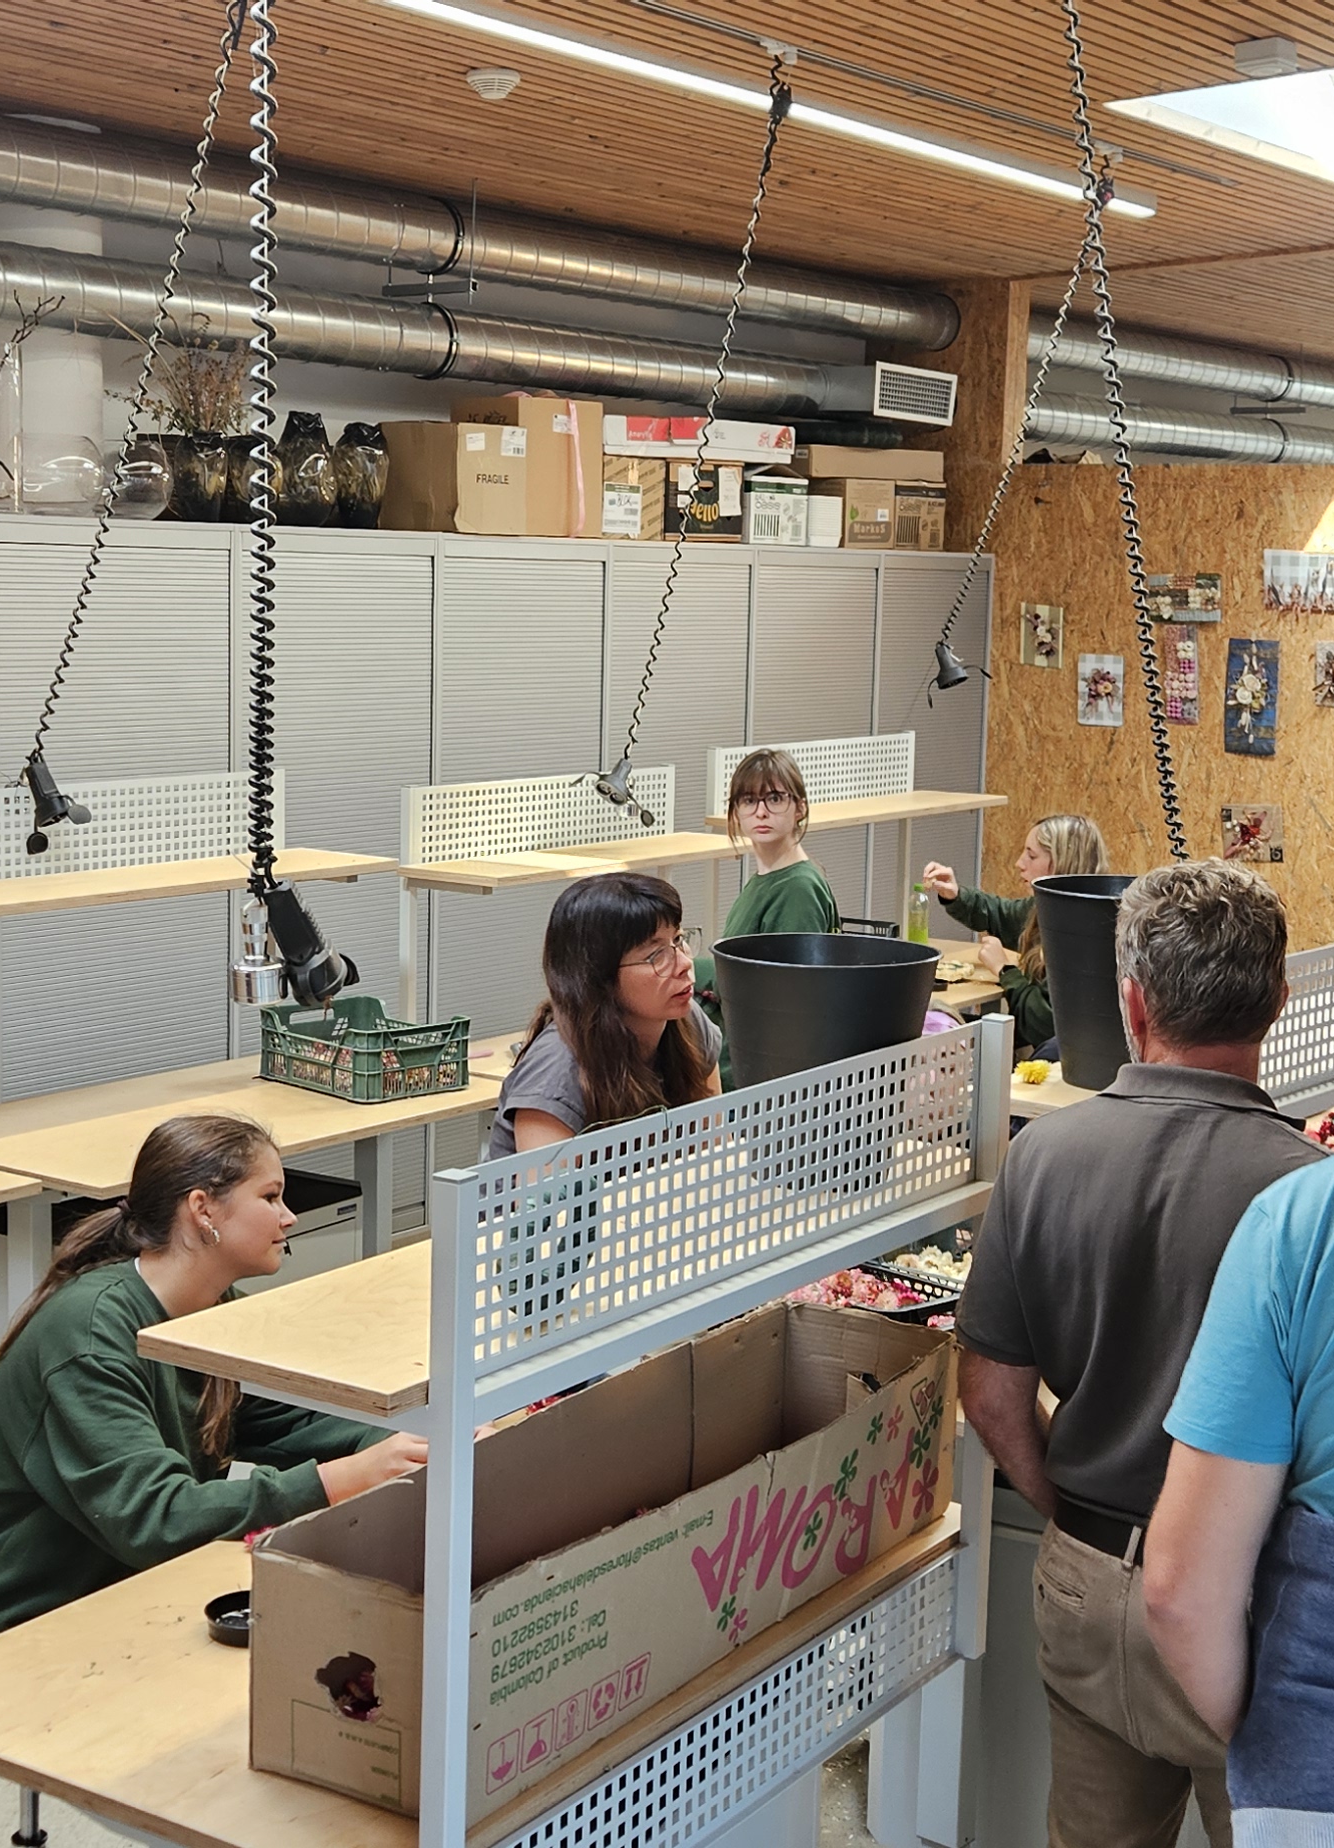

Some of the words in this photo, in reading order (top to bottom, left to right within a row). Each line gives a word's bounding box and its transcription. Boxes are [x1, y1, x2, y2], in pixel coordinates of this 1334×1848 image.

[476, 474, 509, 485] FRAGILE
[691, 1427, 915, 1612] AROMA
[492, 1528, 679, 1627] ventas@floresdelahacienda.com
[491, 1599, 578, 1657] 3143582210
[562, 1631, 609, 1667] Product
[490, 1624, 576, 1683] 3102342679
[546, 1657, 560, 1679] of
[489, 1667, 544, 1707] Colombia
